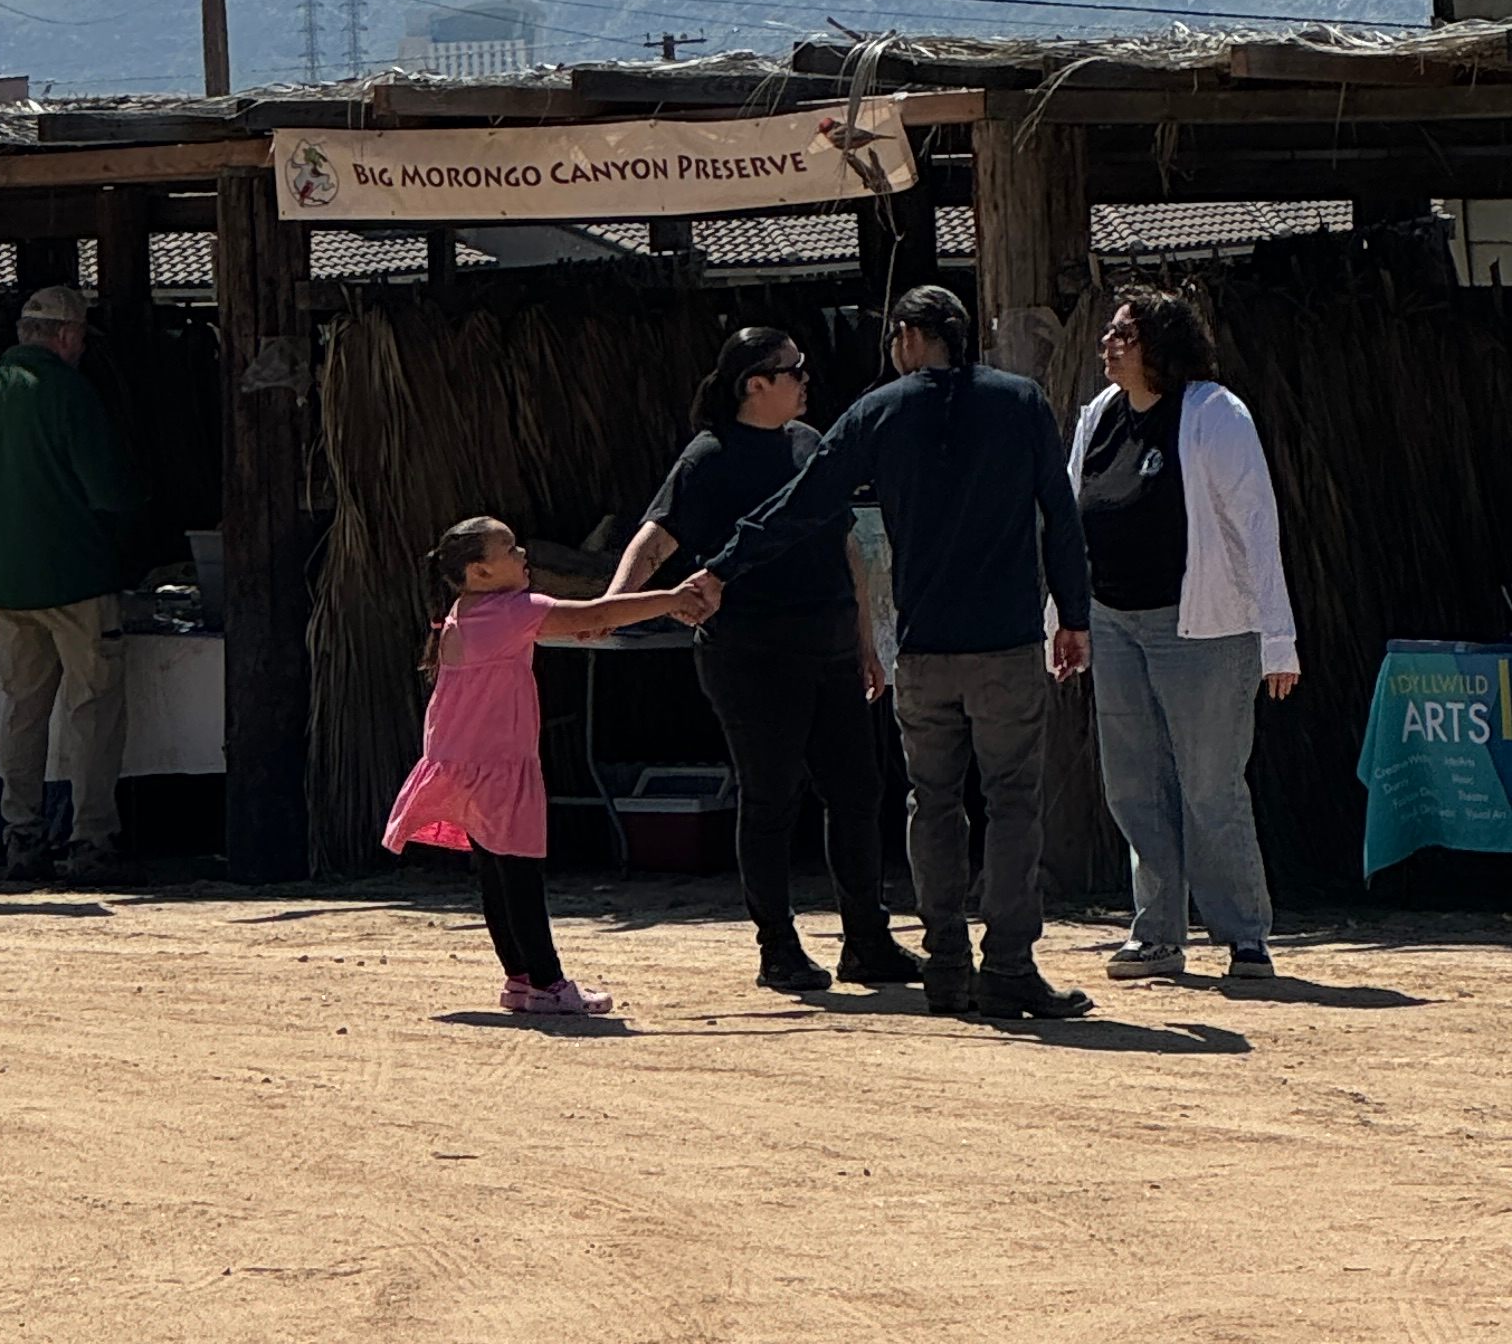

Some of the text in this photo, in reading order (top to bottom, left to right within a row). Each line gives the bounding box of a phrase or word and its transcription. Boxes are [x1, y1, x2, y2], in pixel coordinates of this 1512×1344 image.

[352, 151, 808, 188] BIG MORONGO CANYON PRESERVE
[1390, 674, 1489, 696] IDYLLWILD
[1402, 699, 1491, 745] ARTS
